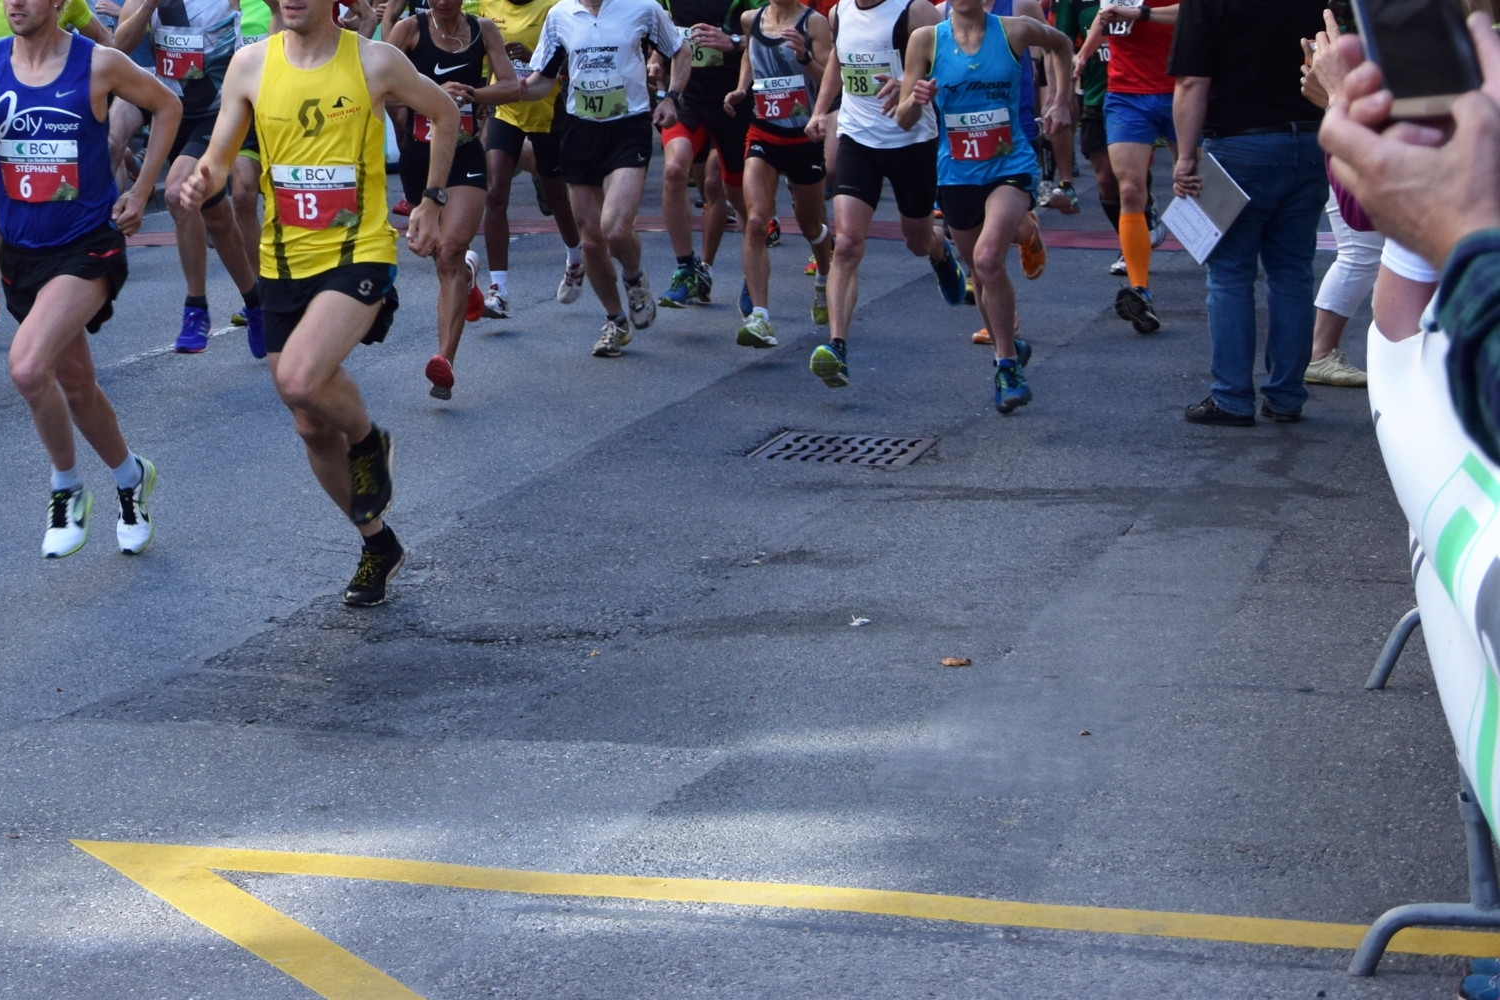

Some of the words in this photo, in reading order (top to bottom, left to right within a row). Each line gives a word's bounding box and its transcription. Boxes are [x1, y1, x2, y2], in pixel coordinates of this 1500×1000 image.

[169, 36, 191, 46] BCV
[855, 53, 875, 63] BCV
[162, 59, 174, 77] 12
[589, 79, 610, 90] BCV
[771, 79, 792, 88] BCV
[847, 76, 868, 93] 738
[765, 92, 791, 100] DANIELA
[763, 101, 781, 117] 26
[970, 113, 994, 125] BCV
[44, 122, 80, 134] voyages
[968, 131, 988, 139] MAYA
[30, 143, 59, 155] BCV
[962, 140, 980, 158] 21
[14, 162, 59, 174] STÉPHANE
[305, 169, 336, 181] BCV
[19, 174, 32, 199] 6
[293, 192, 318, 220] 13
